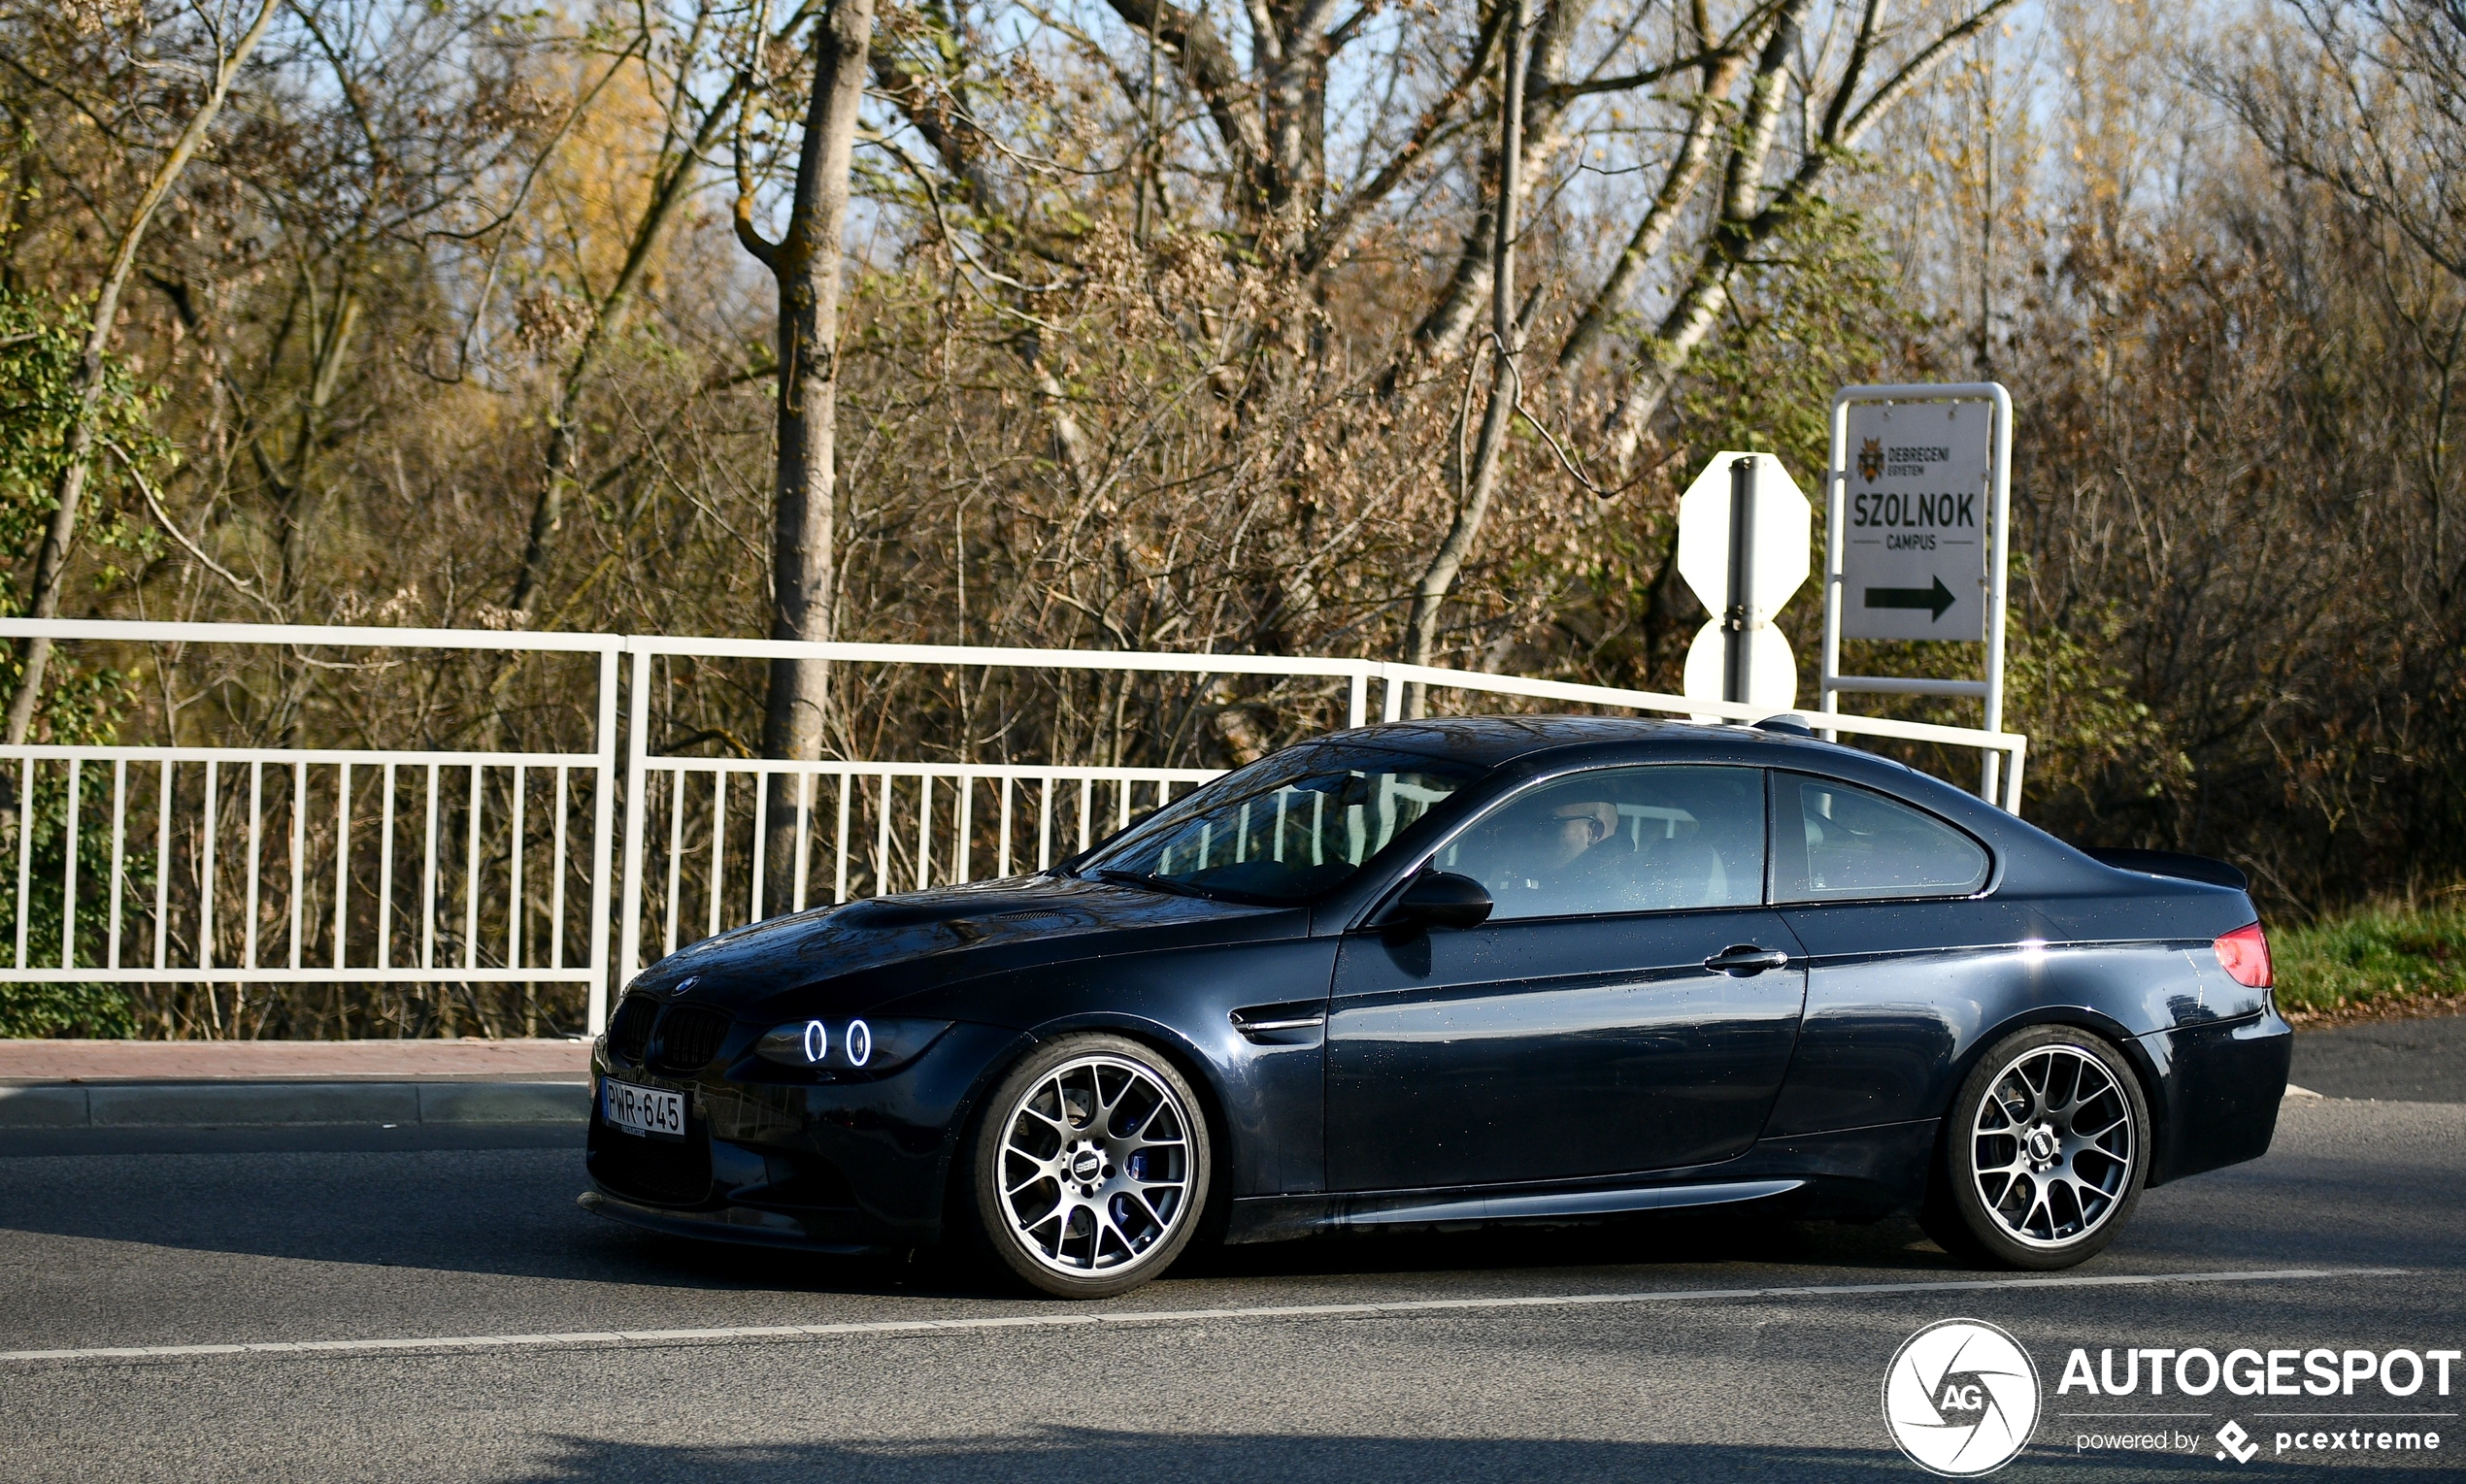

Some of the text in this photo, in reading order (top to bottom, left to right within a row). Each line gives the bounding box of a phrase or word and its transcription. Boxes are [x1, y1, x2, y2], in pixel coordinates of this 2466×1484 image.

[1888, 446, 1949, 462] DEBRECENI
[1853, 493, 1974, 527] SZOLNOK
[1886, 534, 1937, 550] CAMPUS
[609, 1084, 679, 1131] PWR-645
